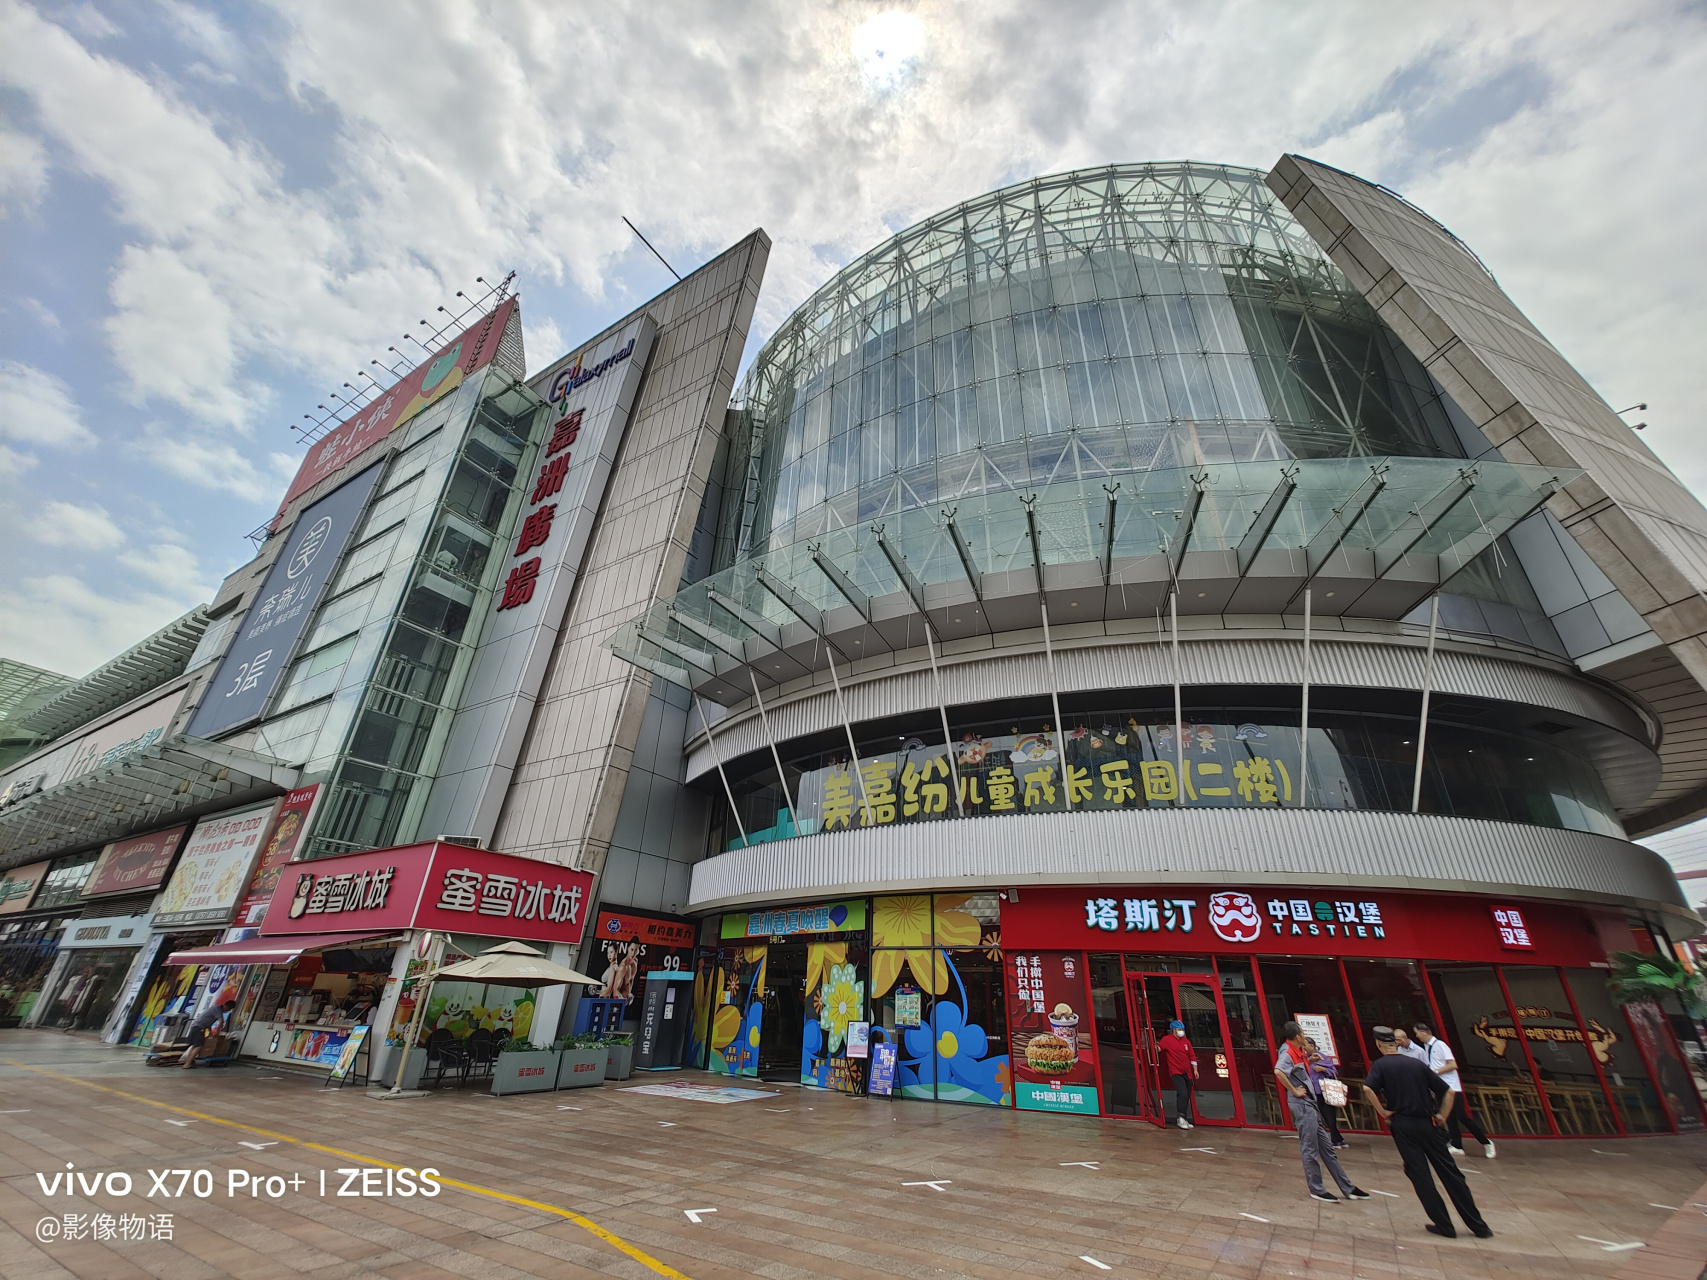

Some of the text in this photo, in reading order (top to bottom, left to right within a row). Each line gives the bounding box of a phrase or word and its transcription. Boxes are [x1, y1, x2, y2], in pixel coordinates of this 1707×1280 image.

[497, 407, 587, 612] 嘉洲廣場
[226, 649, 273, 697] 3层
[305, 866, 393, 914] 蜜雪冰城
[437, 867, 582, 924] 蜜雪冰城
[748, 905, 829, 936] 嘉洲春夏唤醒
[1085, 897, 1197, 932] 塔斯汀
[1267, 899, 1383, 925] 中国 汉堡
[1494, 909, 1524, 928] 中国
[647, 924, 692, 939] 相约嘉美力
[1272, 922, 1386, 938] TASTIEN
[1500, 927, 1532, 946] 汉堡
[664, 955, 680, 971] 99
[1015, 956, 1030, 1000] 我们只做
[1030, 956, 1046, 1013] 手擀中国堡
[518, 1067, 545, 1077] 蜜雪冰城
[1031, 1090, 1083, 1104] 中國漢堡
